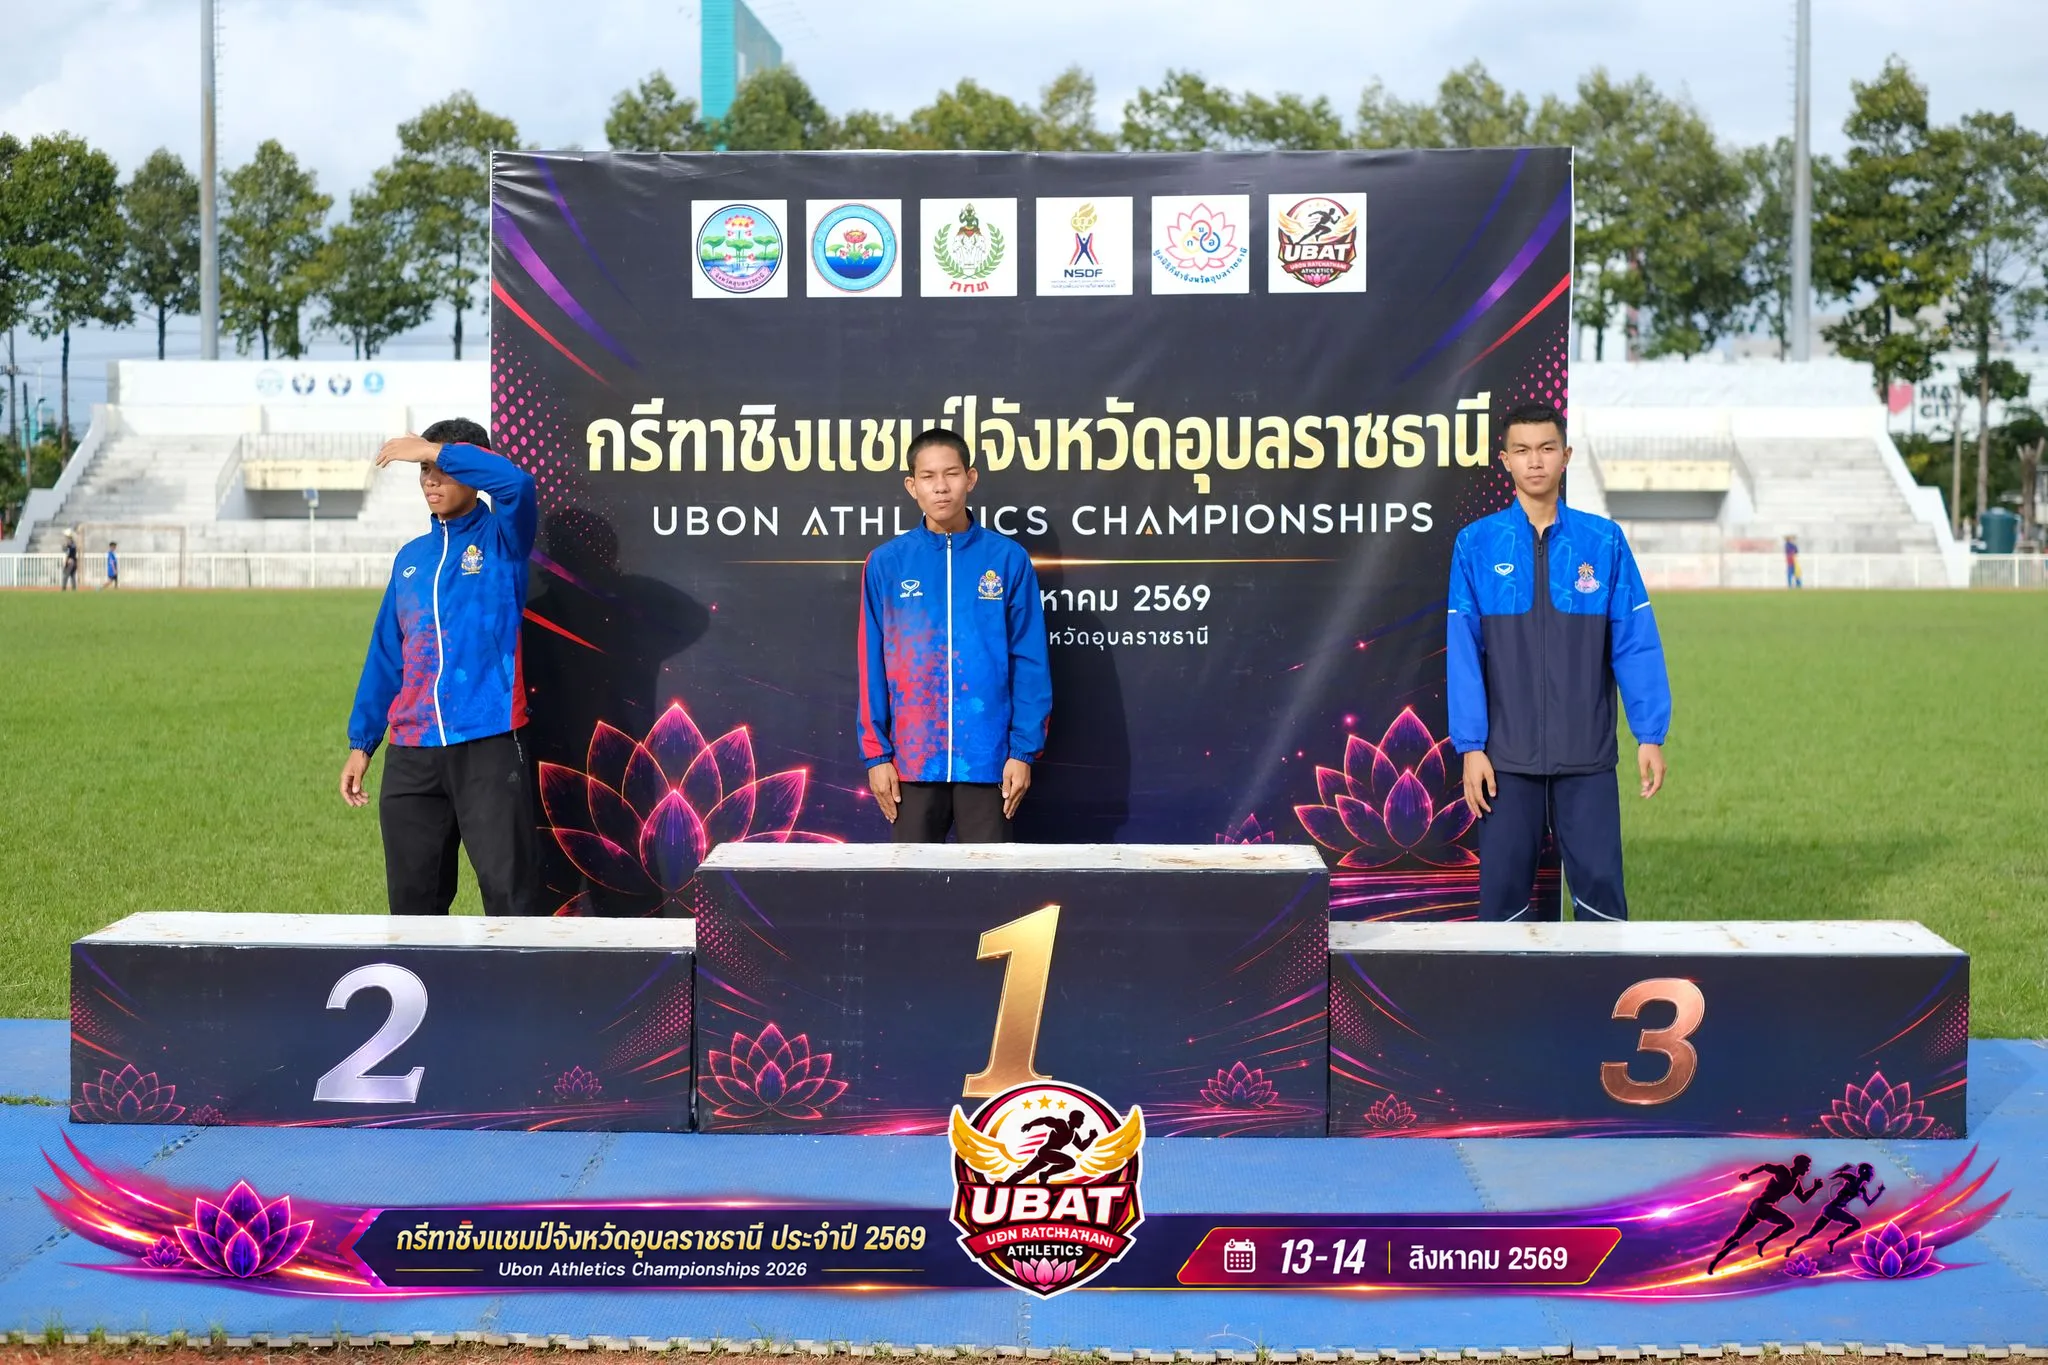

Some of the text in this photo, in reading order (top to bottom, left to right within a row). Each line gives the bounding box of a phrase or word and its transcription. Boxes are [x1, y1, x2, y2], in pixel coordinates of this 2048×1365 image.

[1283, 243, 1351, 262] UBAT
[1064, 268, 1103, 278] NSDF
[653, 501, 1434, 537] UBON ATHLICS CHAMPIONSHIPS
[1133, 584, 1211, 612] 2569
[962, 904, 1063, 1098] 1
[312, 962, 430, 1104] 2
[1599, 977, 1706, 1106] 3
